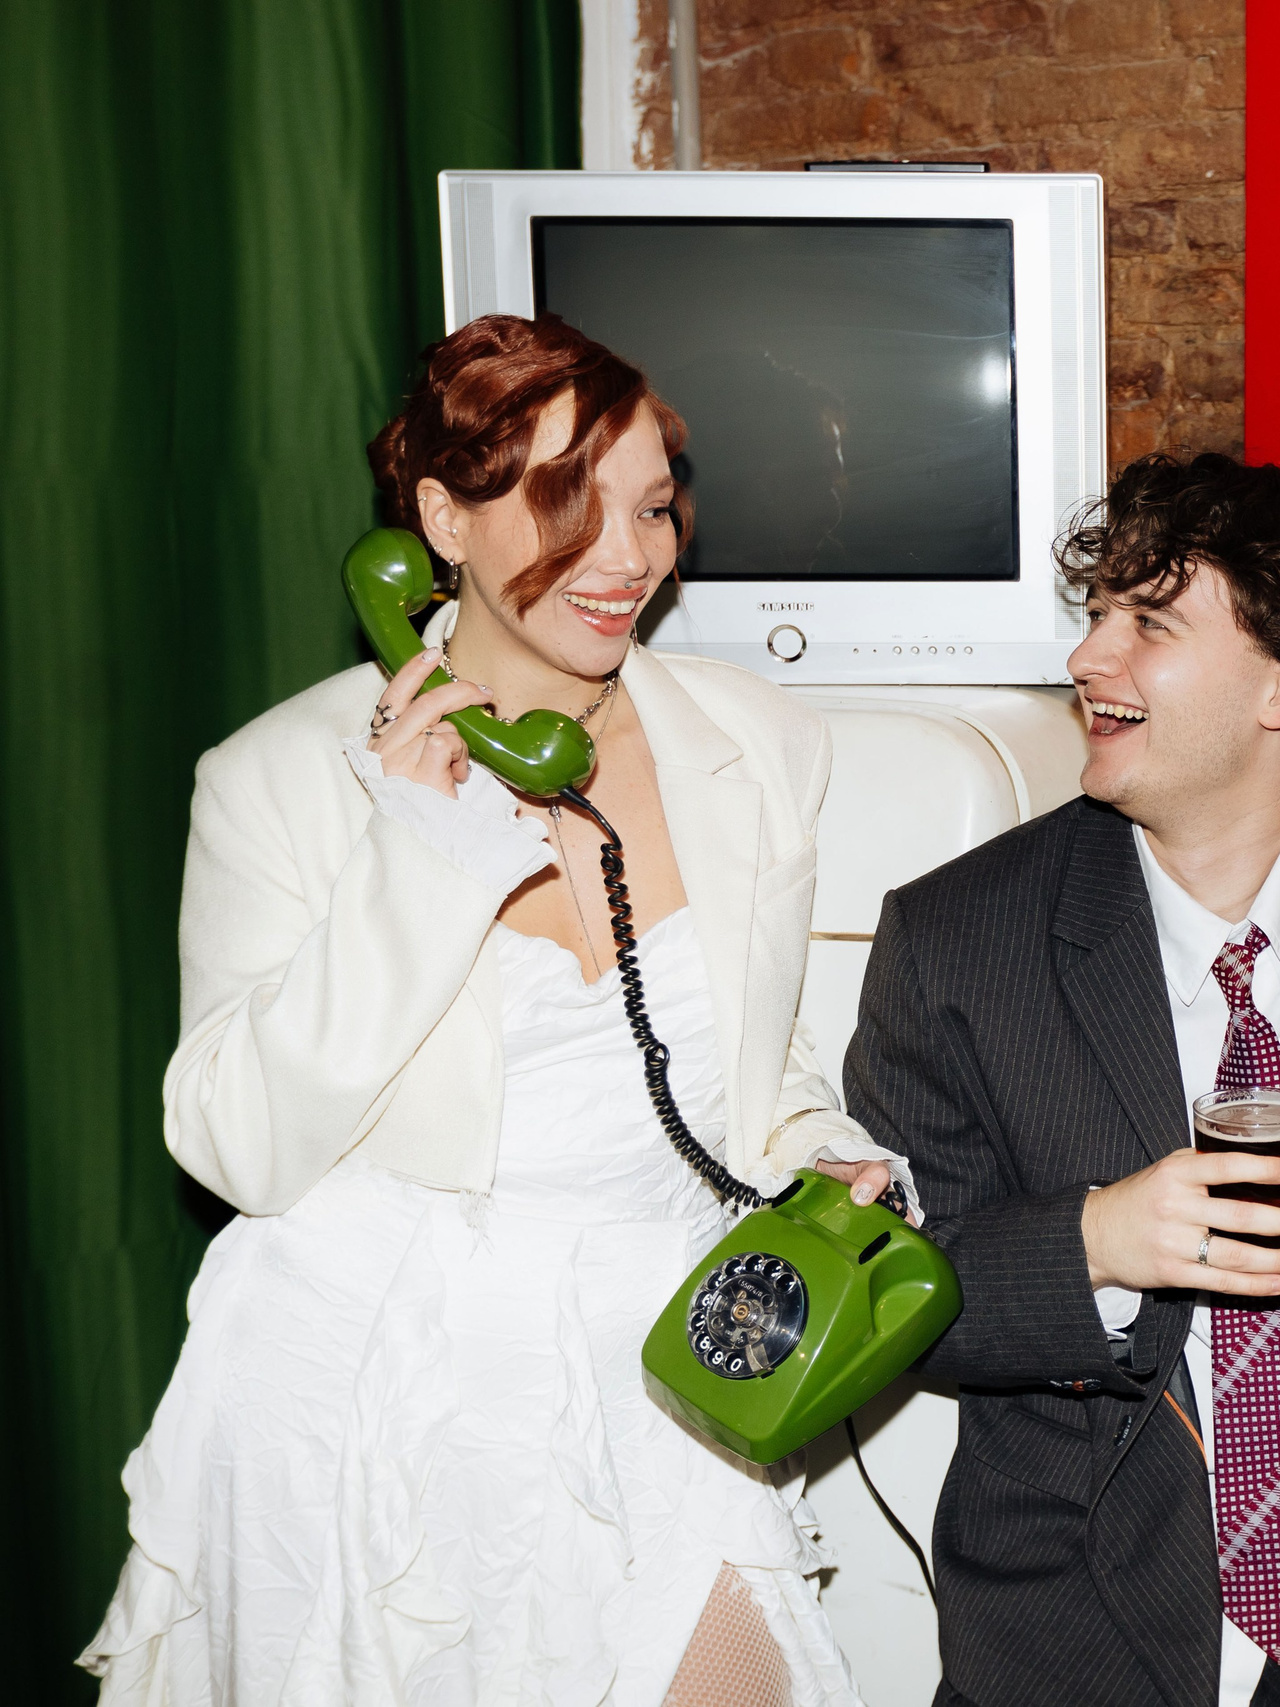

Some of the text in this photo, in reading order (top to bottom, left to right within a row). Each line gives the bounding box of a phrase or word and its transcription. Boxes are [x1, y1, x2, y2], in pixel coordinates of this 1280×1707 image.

[757, 602, 815, 611] SAMSUNG
[700, 1336, 710, 1349] 8
[712, 1351, 724, 1365] 9
[730, 1358, 743, 1371] 0
